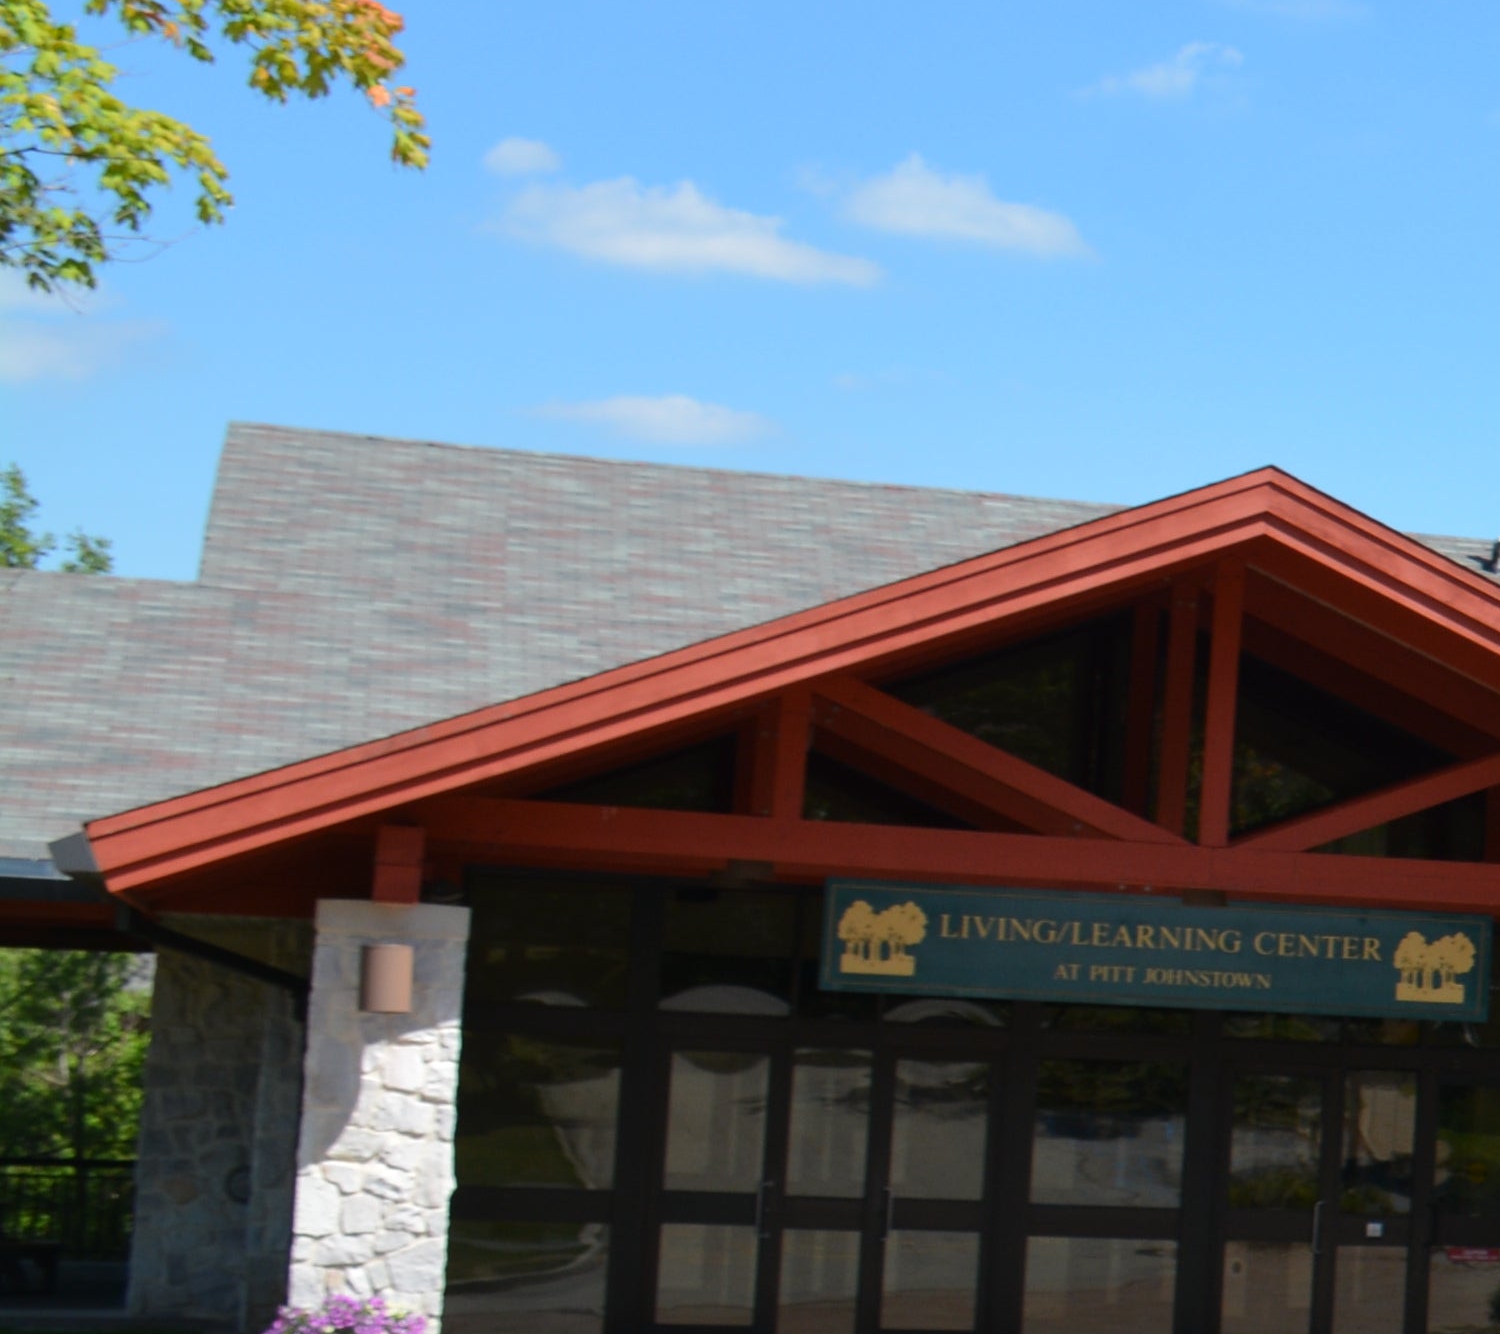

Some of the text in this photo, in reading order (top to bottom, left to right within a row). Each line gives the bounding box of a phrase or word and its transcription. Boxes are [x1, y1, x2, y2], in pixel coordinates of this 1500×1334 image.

[938, 913, 1383, 961] LIVING/LEARNING CENTER
[1054, 963, 1273, 990] AT PITT JOHNSTOWN
